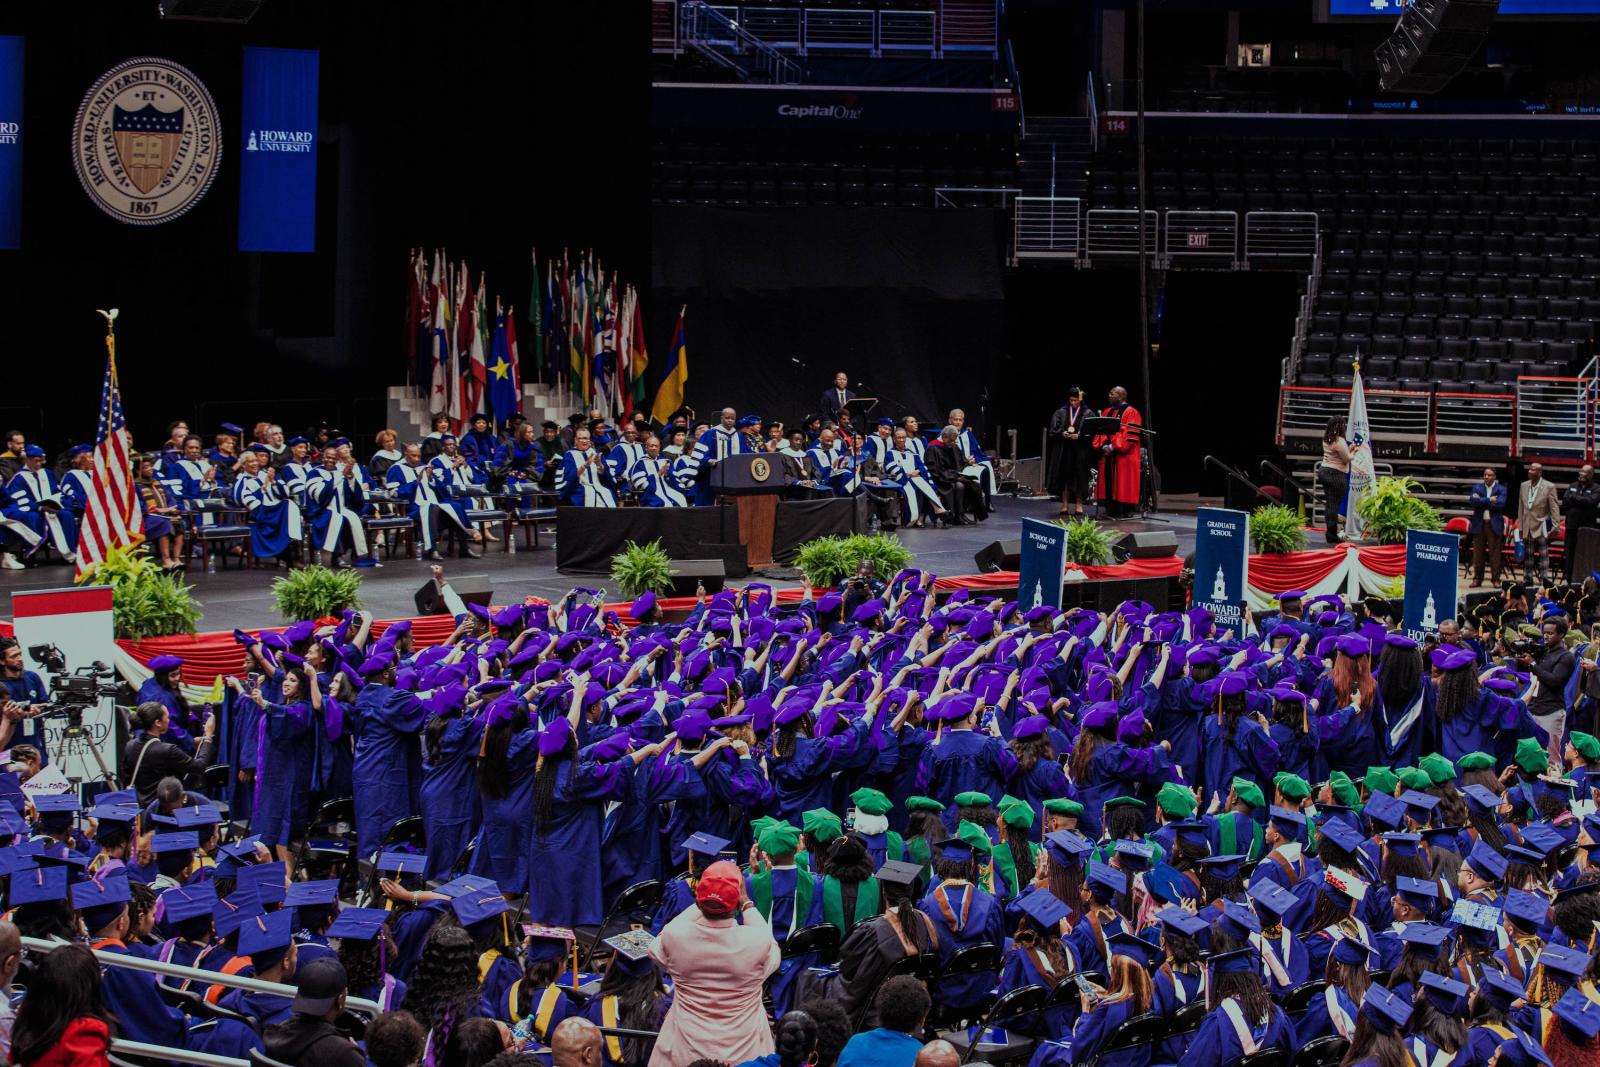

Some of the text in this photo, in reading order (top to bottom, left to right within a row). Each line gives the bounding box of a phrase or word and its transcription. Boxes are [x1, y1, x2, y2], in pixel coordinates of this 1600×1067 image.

[90, 69, 161, 118] UNIVERSITY
[142, 91, 157, 101] ET
[996, 97, 1015, 108] 115
[1106, 120, 1126, 131] 114
[260, 130, 313, 142] HOWARD
[260, 143, 312, 152] UNIVERSITY
[84, 126, 105, 187] HOWARD
[102, 126, 127, 186] VERITAS
[164, 131, 194, 187] UTILITAS
[130, 202, 158, 213] 1867
[1189, 234, 1207, 246] EXIT
[1207, 521, 1237, 530] GRADUATE
[1029, 532, 1048, 542] SCHOOL
[1210, 529, 1233, 537] SCHOOL
[1036, 542, 1048, 551] LAW
[1415, 543, 1441, 553] COLLEGE
[1416, 551, 1449, 562] PHARMACY
[1214, 615, 1240, 626] ERSITY
